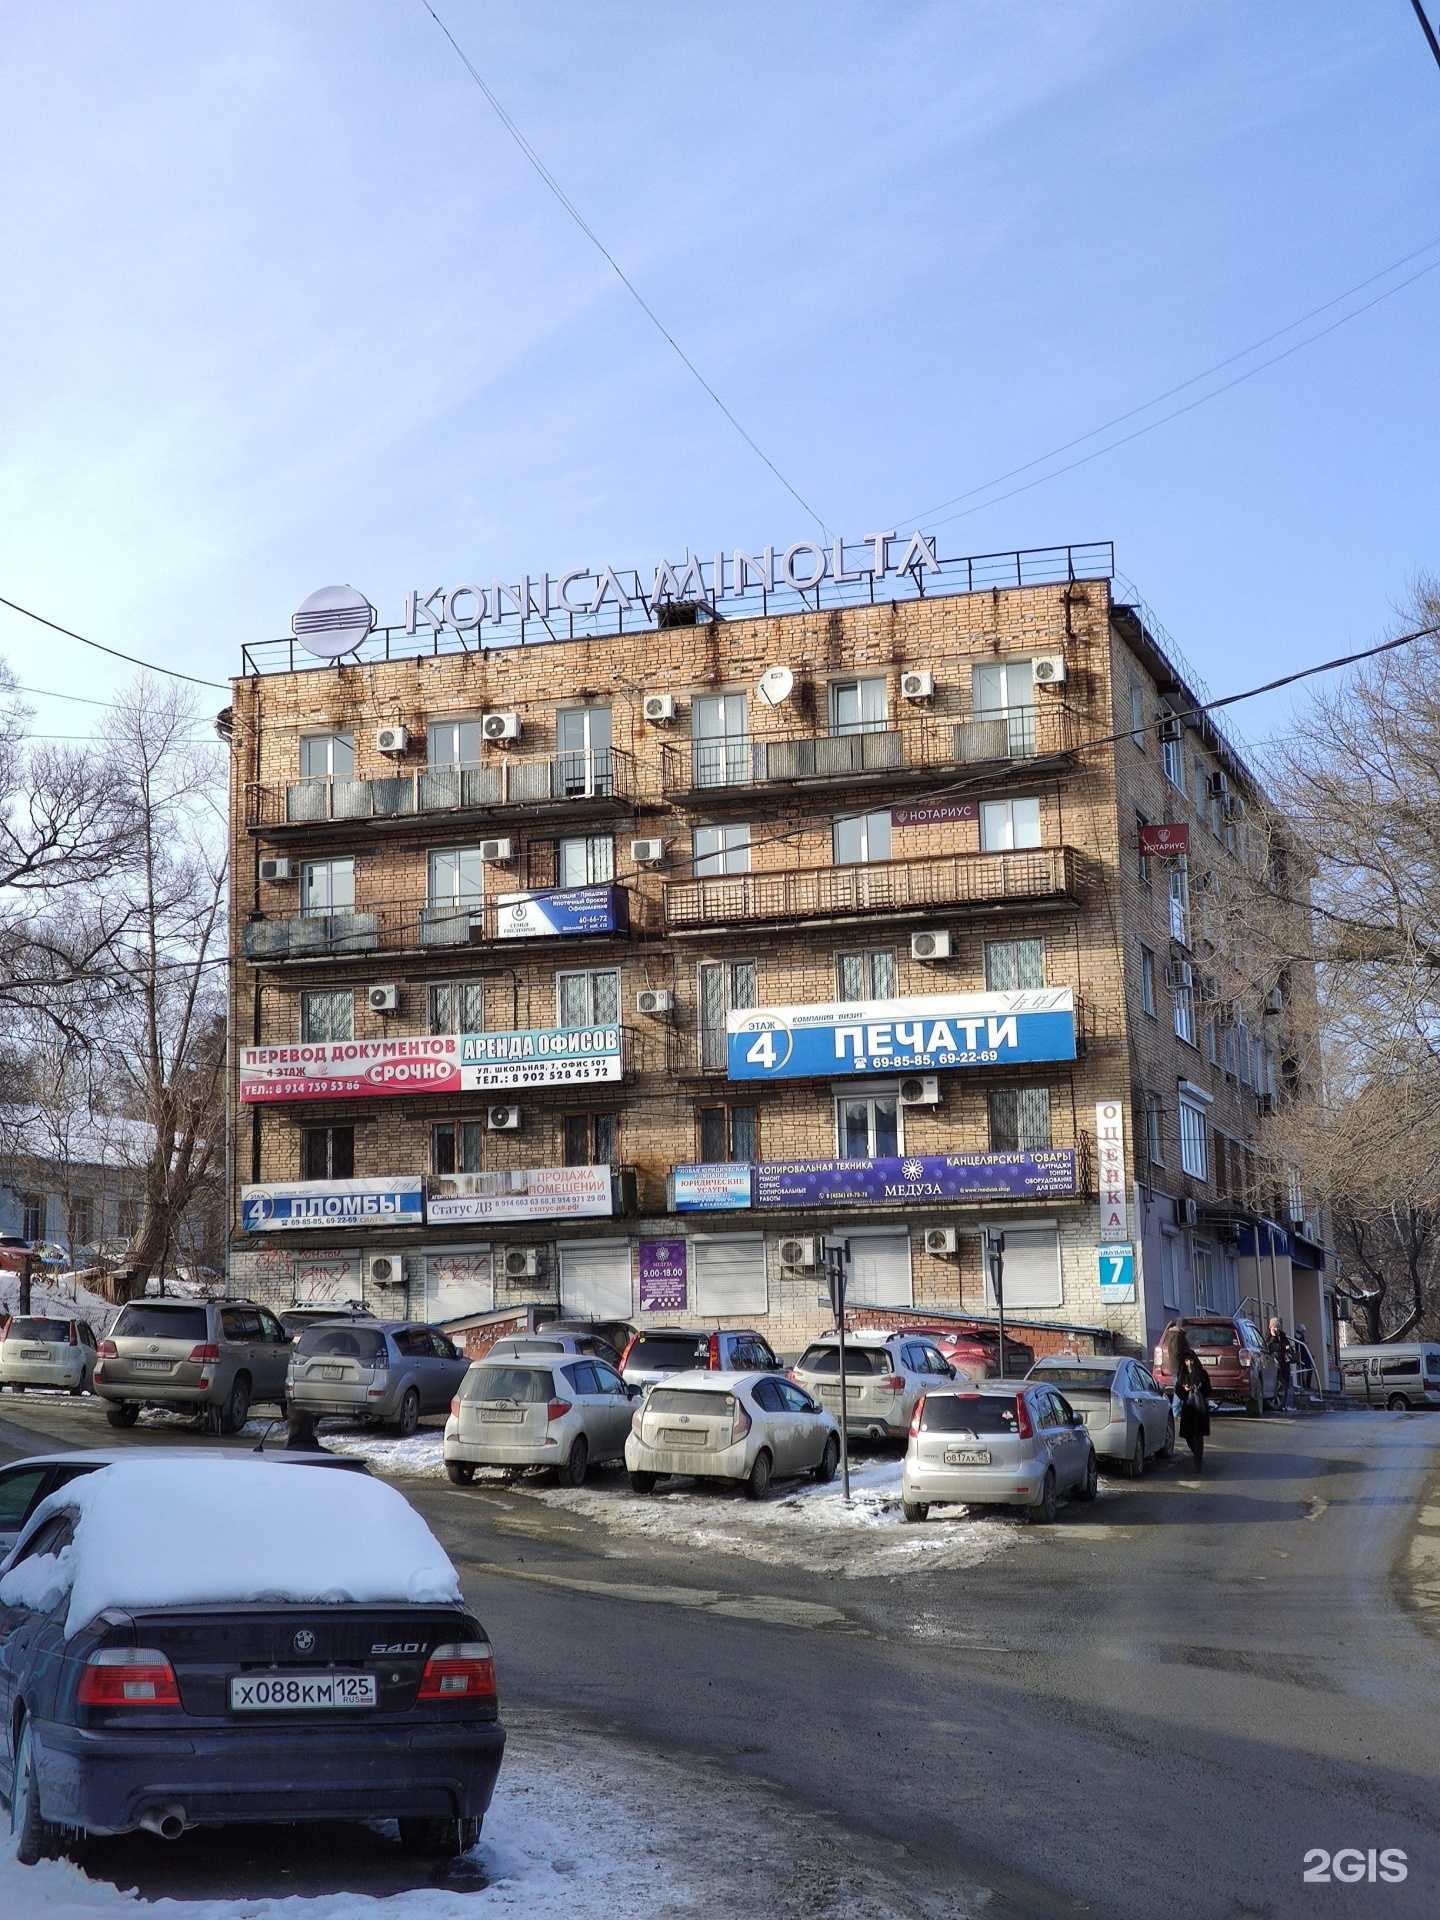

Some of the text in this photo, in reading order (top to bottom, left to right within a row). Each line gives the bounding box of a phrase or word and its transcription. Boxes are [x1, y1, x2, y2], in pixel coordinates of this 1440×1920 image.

[405, 530, 943, 634] KONICA MINOLTA
[910, 806, 971, 820] НОТАРИУС
[1144, 842, 1185, 852] НОТАРИУС
[748, 1021, 775, 1030] ЭТАЖ
[463, 1030, 617, 1060] АРЕНДА ОФИСОВ
[834, 1017, 1018, 1058] ПЕЧАТИ
[246, 1039, 456, 1064] ПЕРЕВОД ДОКУМЕНТОВ
[746, 1032, 777, 1068] 4
[495, 1064, 549, 1073] ШКОЛЬНАЯ,
[561, 1061, 588, 1069] ОФИС
[591, 1059, 606, 1067] 507
[872, 1051, 997, 1068] 69-85-85, 69-22-69
[276, 1067, 306, 1077] ЭТАЖ
[370, 1063, 450, 1082] СРОЧНО
[476, 1068, 608, 1085] ТЕЛ.: 8 902 528 45 72
[245, 1085, 272, 1096] ТЕЛ.:
[275, 1086, 282, 1094] 8
[284, 1084, 304, 1093] 914
[308, 1083, 327, 1092] 739
[759, 1161, 873, 1175] КОПИРОВАЛЬНАЯ ТЕХНИКА
[946, 1152, 1071, 1167] КАНЦЕЛЯРСКИЕ ТОВАРЫ
[1103, 1105, 1121, 1226] ОЦЕНКА
[537, 1170, 595, 1182] ПРОДАЖА
[529, 1181, 605, 1195] ПОМЕЩЕНИИ
[885, 1183, 942, 1197] МЕДУЗА
[249, 1200, 265, 1221] 4
[290, 1194, 401, 1217] ПЛОМБЫ
[432, 1201, 493, 1217] Статус ДВ
[1109, 1257, 1124, 1283] 7
[241, 1679, 369, 1704] Х088КМ 125
